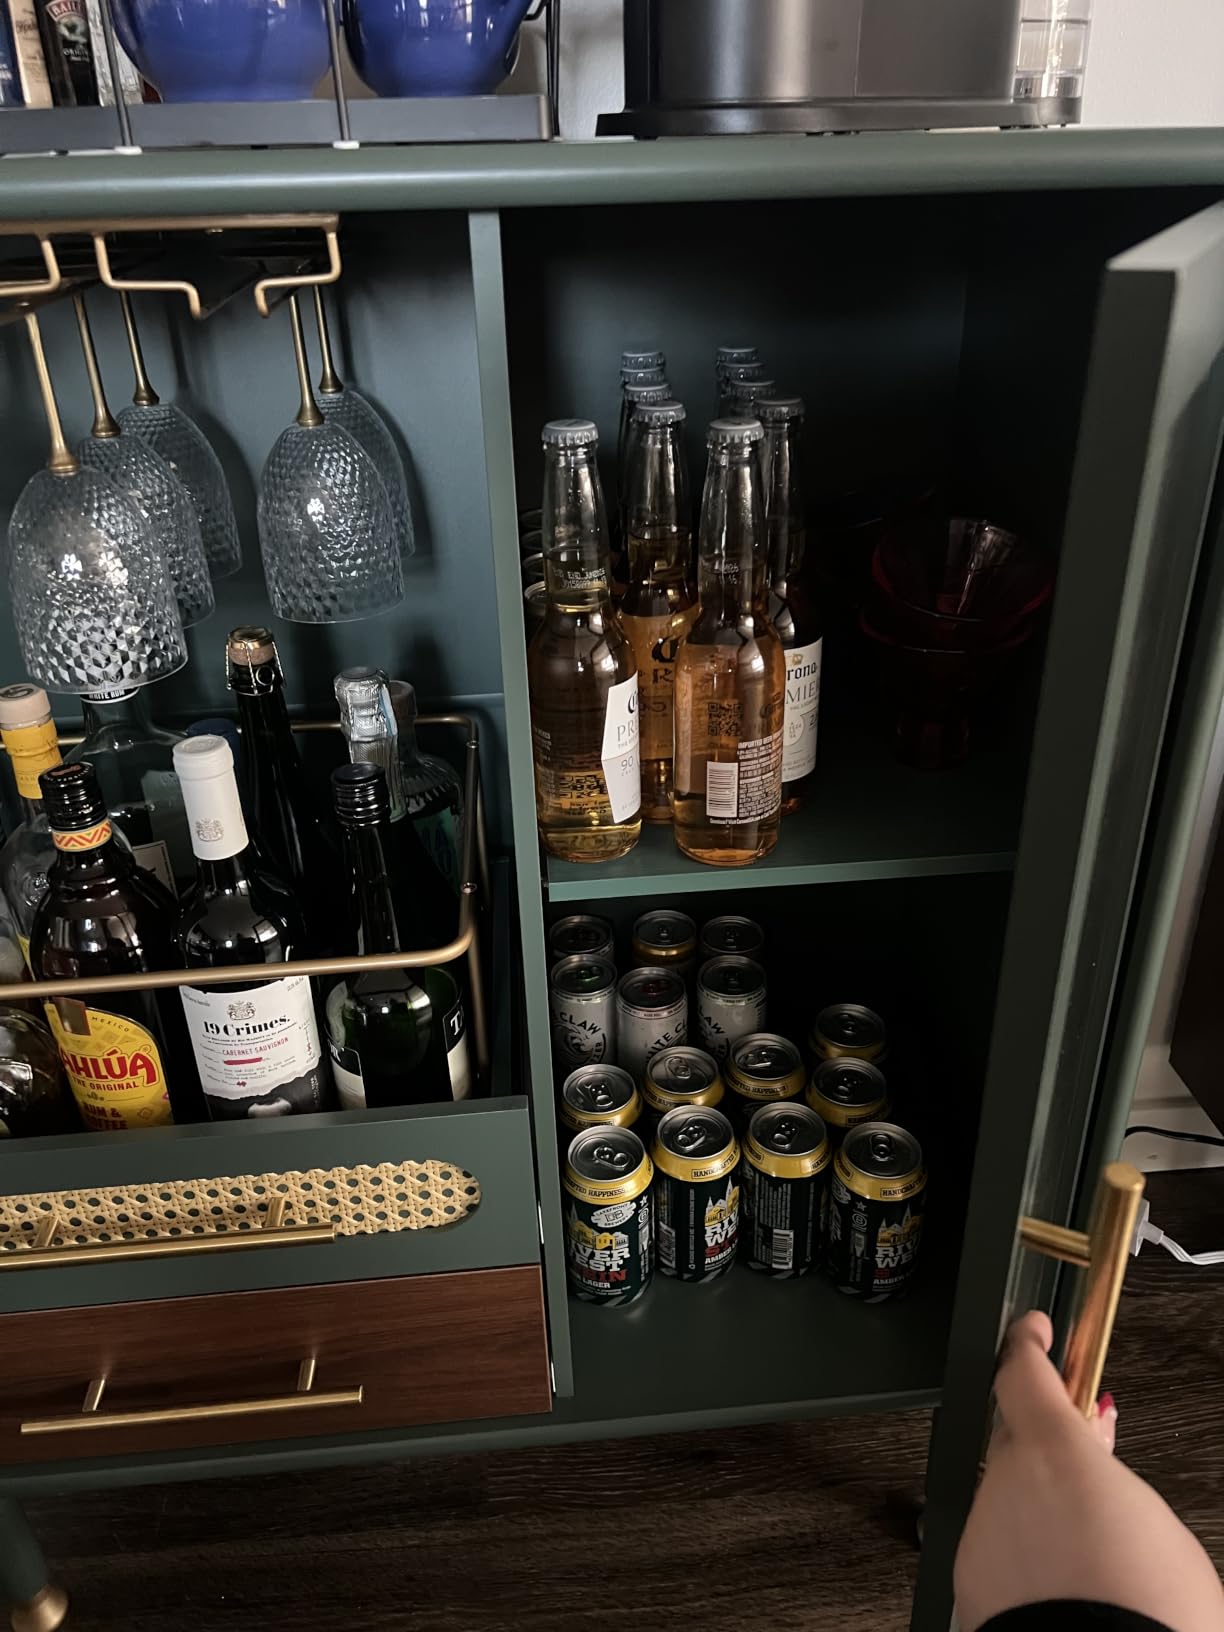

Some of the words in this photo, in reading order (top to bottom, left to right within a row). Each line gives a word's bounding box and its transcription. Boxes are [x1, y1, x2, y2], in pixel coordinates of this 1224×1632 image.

[110, 689, 125, 699] RUM
[787, 680, 819, 704] MIE
[621, 755, 634, 771] 90
[91, 1015, 130, 1033] MEXICO
[203, 1020, 220, 1036] 19
[560, 1011, 602, 1035] CLAW
[221, 1047, 254, 1057] CABERNET
[254, 1036, 289, 1054] SAUVIGNON
[72, 1077, 87, 1088] THE
[89, 1081, 139, 1091] ORIGINAL
[110, 1107, 123, 1118] &
[705, 1246, 732, 1265] AMBER
[582, 1277, 611, 1289] LAGER
